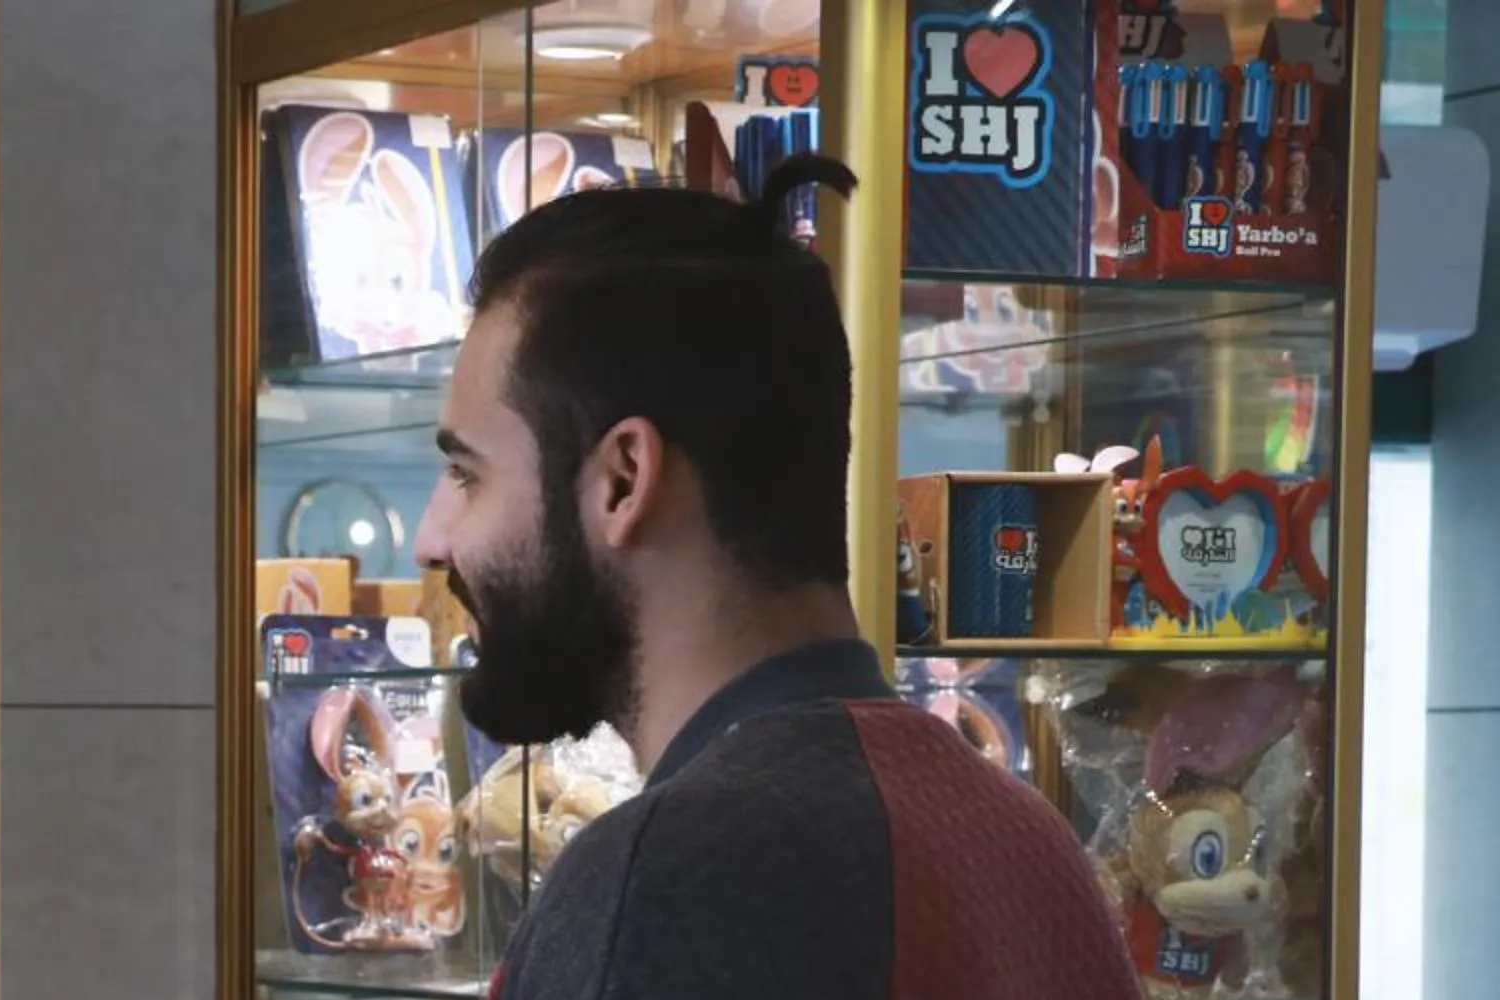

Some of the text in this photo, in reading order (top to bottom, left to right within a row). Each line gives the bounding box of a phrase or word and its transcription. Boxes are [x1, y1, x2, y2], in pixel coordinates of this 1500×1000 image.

[925, 31, 960, 97] I
[920, 104, 1040, 170] SHJ
[1190, 202, 1203, 226] I
[1188, 227, 1229, 252] SHJ
[1236, 224, 1318, 246] Yarbo'a
[1162, 950, 1210, 976] SHJ
